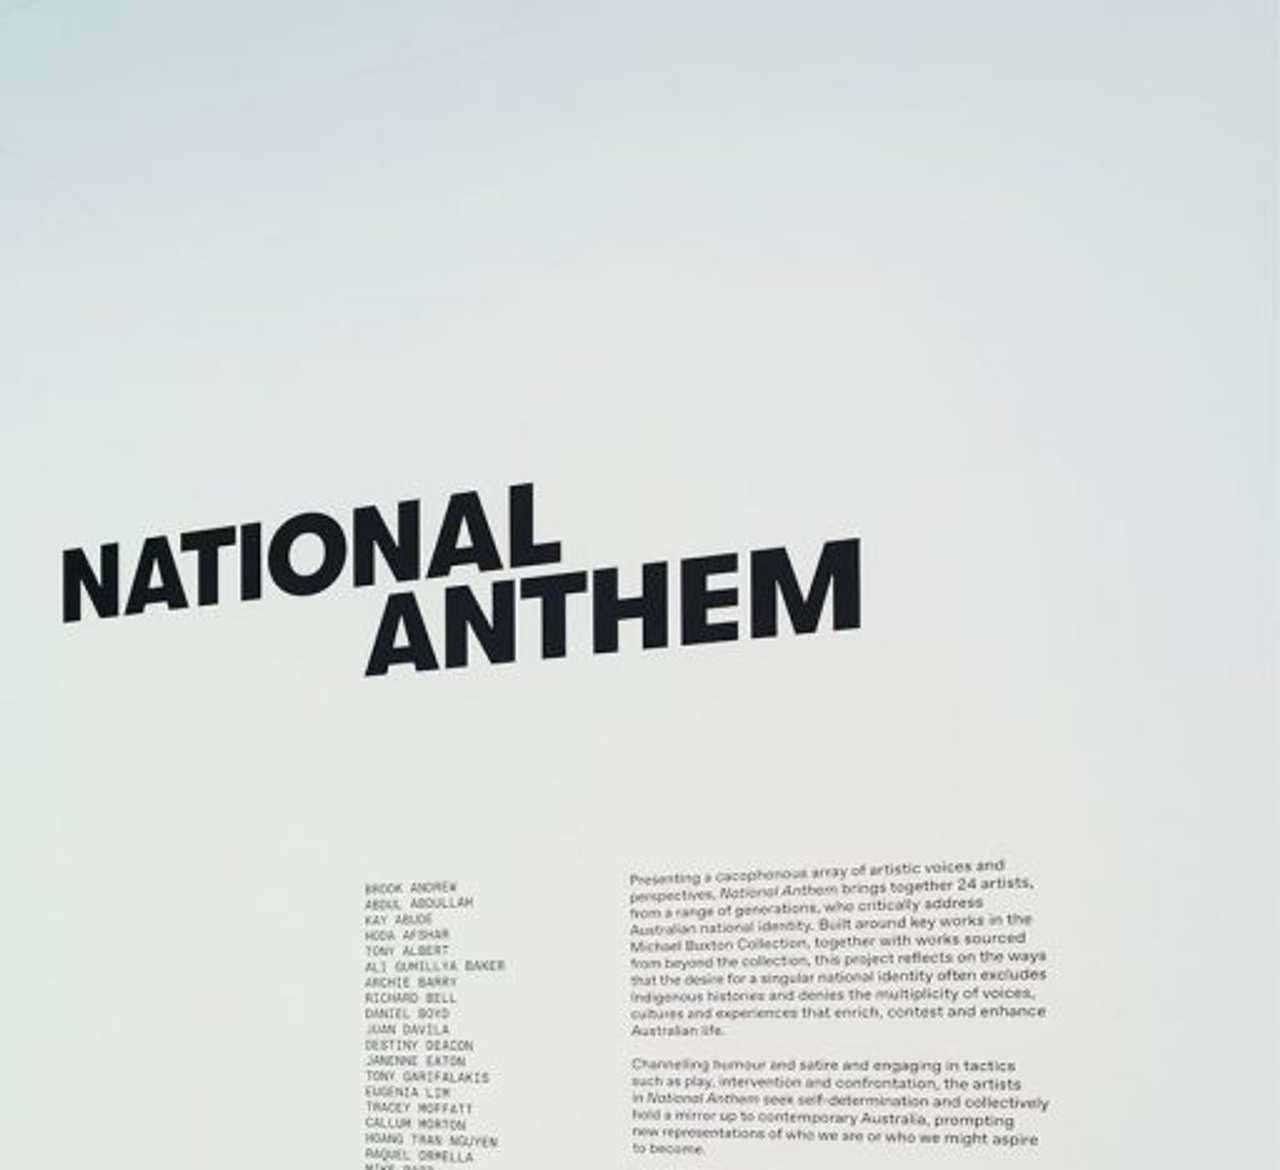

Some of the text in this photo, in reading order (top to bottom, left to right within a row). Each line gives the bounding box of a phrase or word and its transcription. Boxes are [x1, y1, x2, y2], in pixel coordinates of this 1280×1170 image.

[63, 482, 561, 623] NATIONAL
[364, 538, 861, 676] ANTHEM
[629, 858, 1006, 888] Presenting a cacophonous array of artistic voices and
[718, 886, 779, 899] National
[840, 881, 887, 897] brings
[888, 879, 954, 895] together
[956, 878, 977, 890] 24
[979, 875, 1034, 891] artists,
[629, 907, 662, 919] from
[664, 909, 673, 918] a
[674, 907, 714, 920] range
[716, 905, 732, 916] of
[822, 900, 855, 913] who
[856, 898, 922, 914] critically
[922, 896, 984, 909] address
[629, 923, 698, 935] Australian
[698, 921, 755, 934] national
[854, 916, 906, 929] around
[909, 915, 936, 930] key
[938, 914, 984, 927] works
[1006, 912, 1032, 925] the
[629, 931, 1026, 952] Michael Collection, together with works sourced
[629, 950, 1046, 971] from beyond the collection, this project reflects on the ways
[658, 967, 1047, 986] the for a singular national identity often excludes
[706, 990, 766, 1001] histories
[767, 989, 795, 1001] and
[797, 989, 845, 1000] denies
[847, 988, 872, 1000] the
[874, 987, 960, 1002] multiplicity
[961, 987, 980, 999] of
[686, 1004, 1046, 1021] and experiences that enrich, contest and enhance
[630, 1024, 698, 1035] Australian
[769, 1059, 796, 1070] and
[798, 1059, 839, 1070] satire
[841, 1059, 869, 1071] and
[872, 1059, 942, 1074] engaging
[944, 1060, 960, 1071] in
[962, 1060, 1016, 1072] tactics
[631, 1075, 664, 1086] such
[664, 1077, 682, 1086] as
[716, 1076, 802, 1087] intervention
[804, 1076, 832, 1088] and
[834, 1077, 941, 1090] confrontation,
[942, 1077, 969, 1089] the
[971, 1078, 1021, 1090] artists
[631, 1092, 644, 1102] in
[646, 1092, 704, 1103] National
[762, 1093, 794, 1105] seek
[930, 1095, 962, 1107] and
[963, 1096, 1049, 1111] collectively
[631, 1109, 1015, 1129] hold a mirror up to contemporary Australia, prompting
[632, 1141, 645, 1152] to
[661, 1126, 1038, 1148] representations of who we are or who we might aspire
